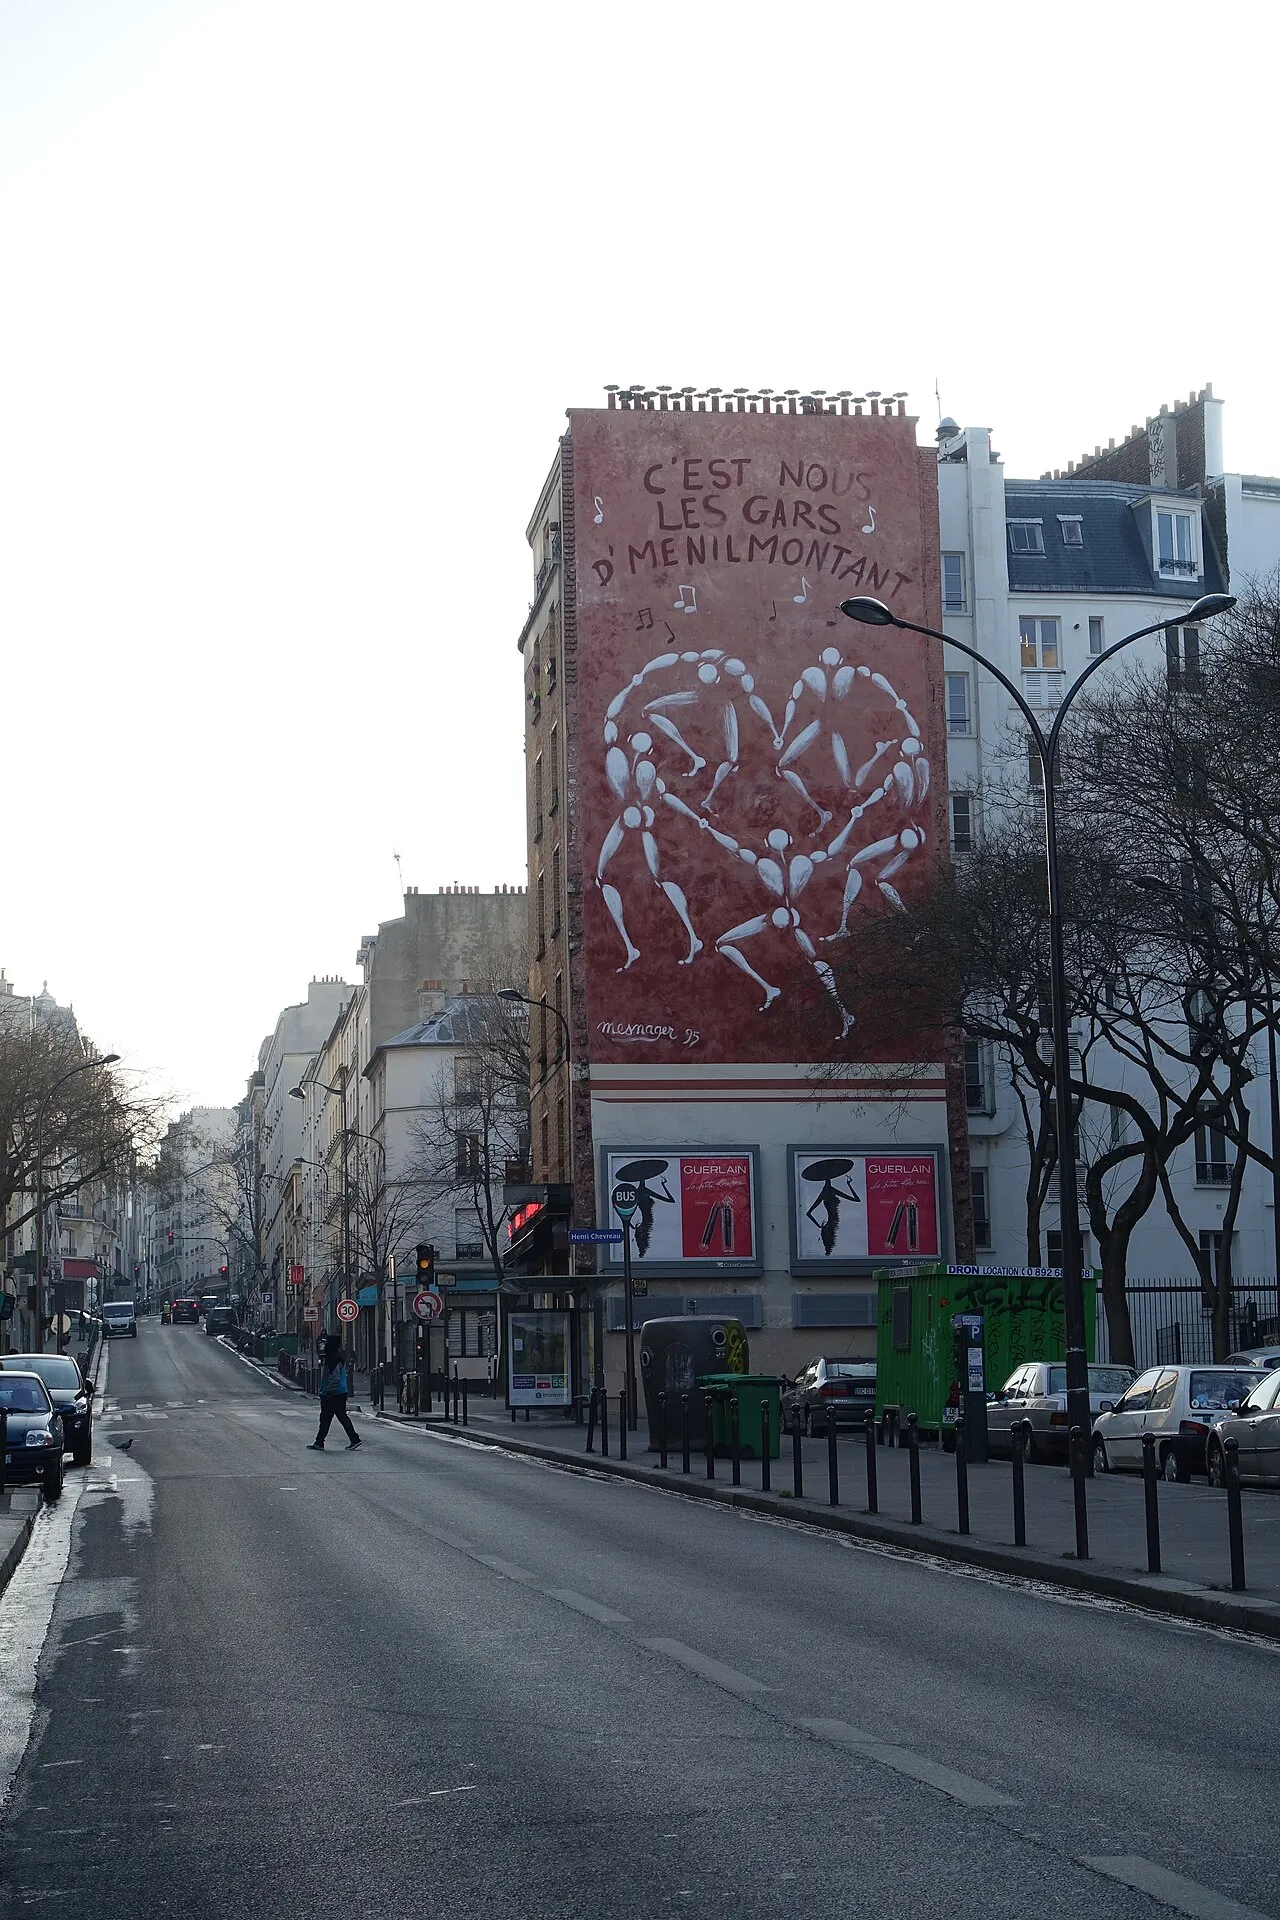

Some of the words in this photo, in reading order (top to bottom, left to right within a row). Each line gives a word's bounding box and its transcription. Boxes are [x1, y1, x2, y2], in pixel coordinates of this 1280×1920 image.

[644, 456, 751, 494] C'EST
[779, 459, 873, 501] NOUS
[657, 494, 728, 531] LES
[742, 494, 842, 535] GARS
[682, 1028, 701, 1048] 95
[683, 1165, 747, 1175] GUERLAIN
[868, 1164, 932, 1174] GUERLAIN
[615, 1190, 636, 1202] BUS
[571, 1232, 589, 1240] Henri
[590, 1232, 621, 1240] Chevreau
[948, 1265, 980, 1275] DRON
[982, 1266, 1019, 1276] LOCATION
[1035, 1268, 1052, 1277] 892
[635, 1280, 645, 1288] 96
[264, 1294, 271, 1302] P
[341, 1306, 354, 1316] 30
[971, 1325, 980, 1339] P
